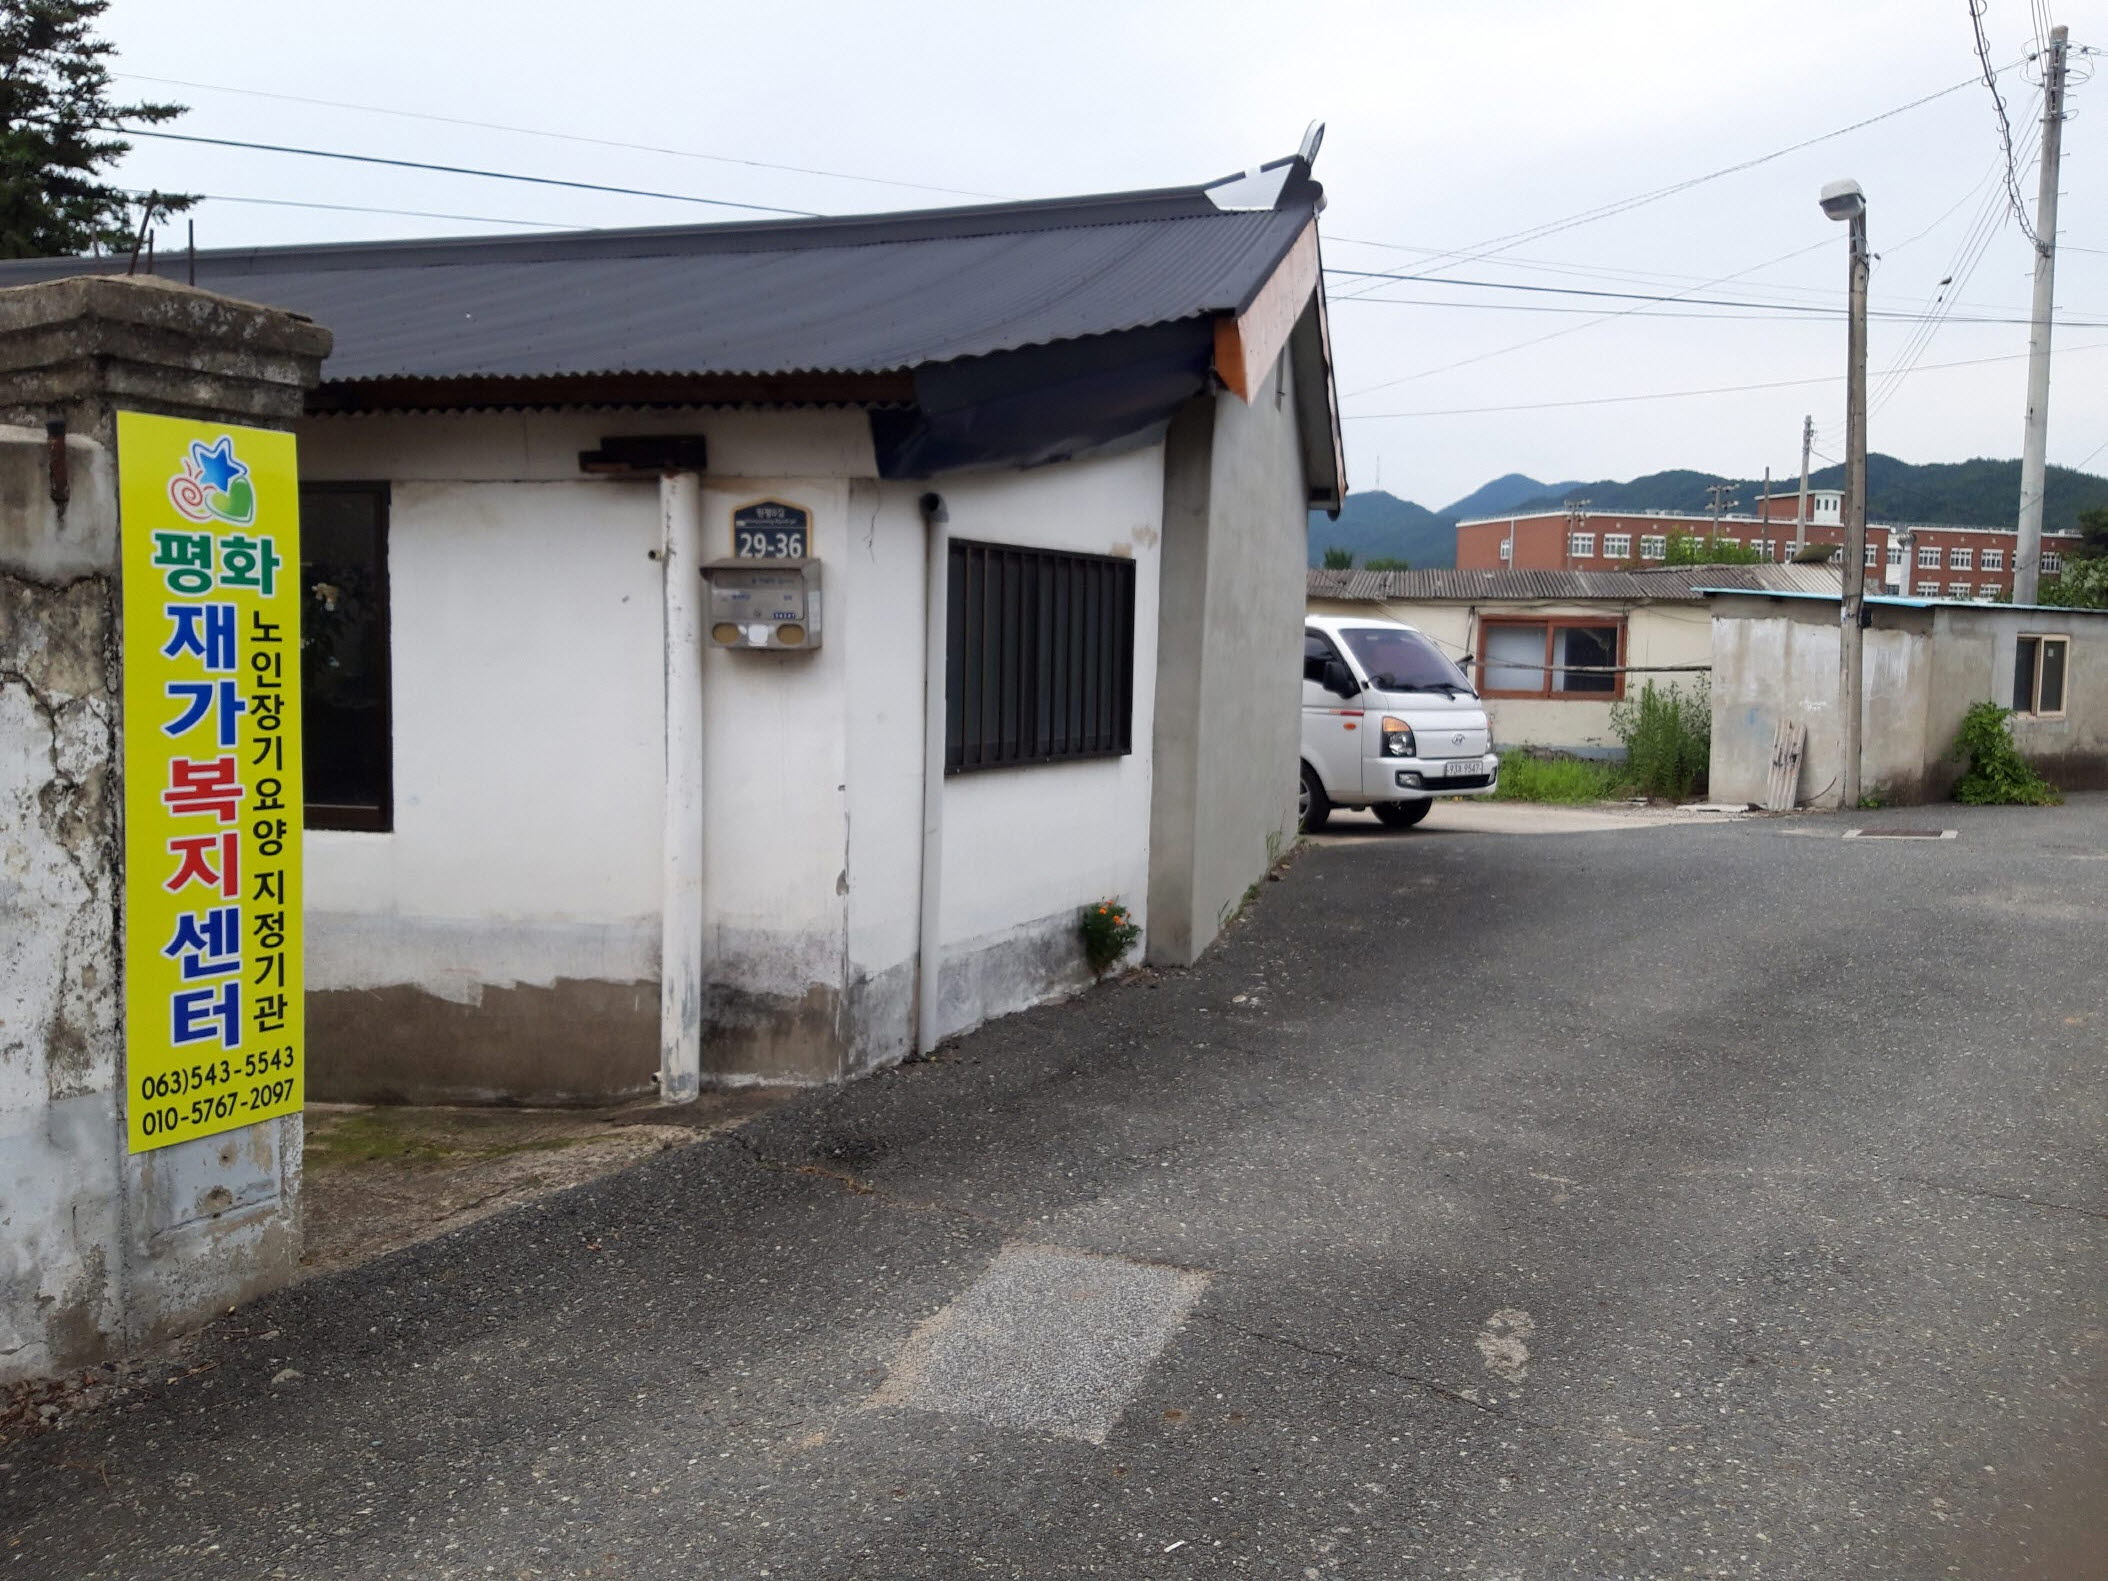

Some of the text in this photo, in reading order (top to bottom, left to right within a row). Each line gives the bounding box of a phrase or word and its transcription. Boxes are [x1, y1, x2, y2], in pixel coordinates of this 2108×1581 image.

[153, 531, 281, 595] 평화
[739, 532, 802, 559] 29-36
[141, 1045, 295, 1101] 063)543-5543
[142, 1077, 295, 1137] 010-5767-2097
